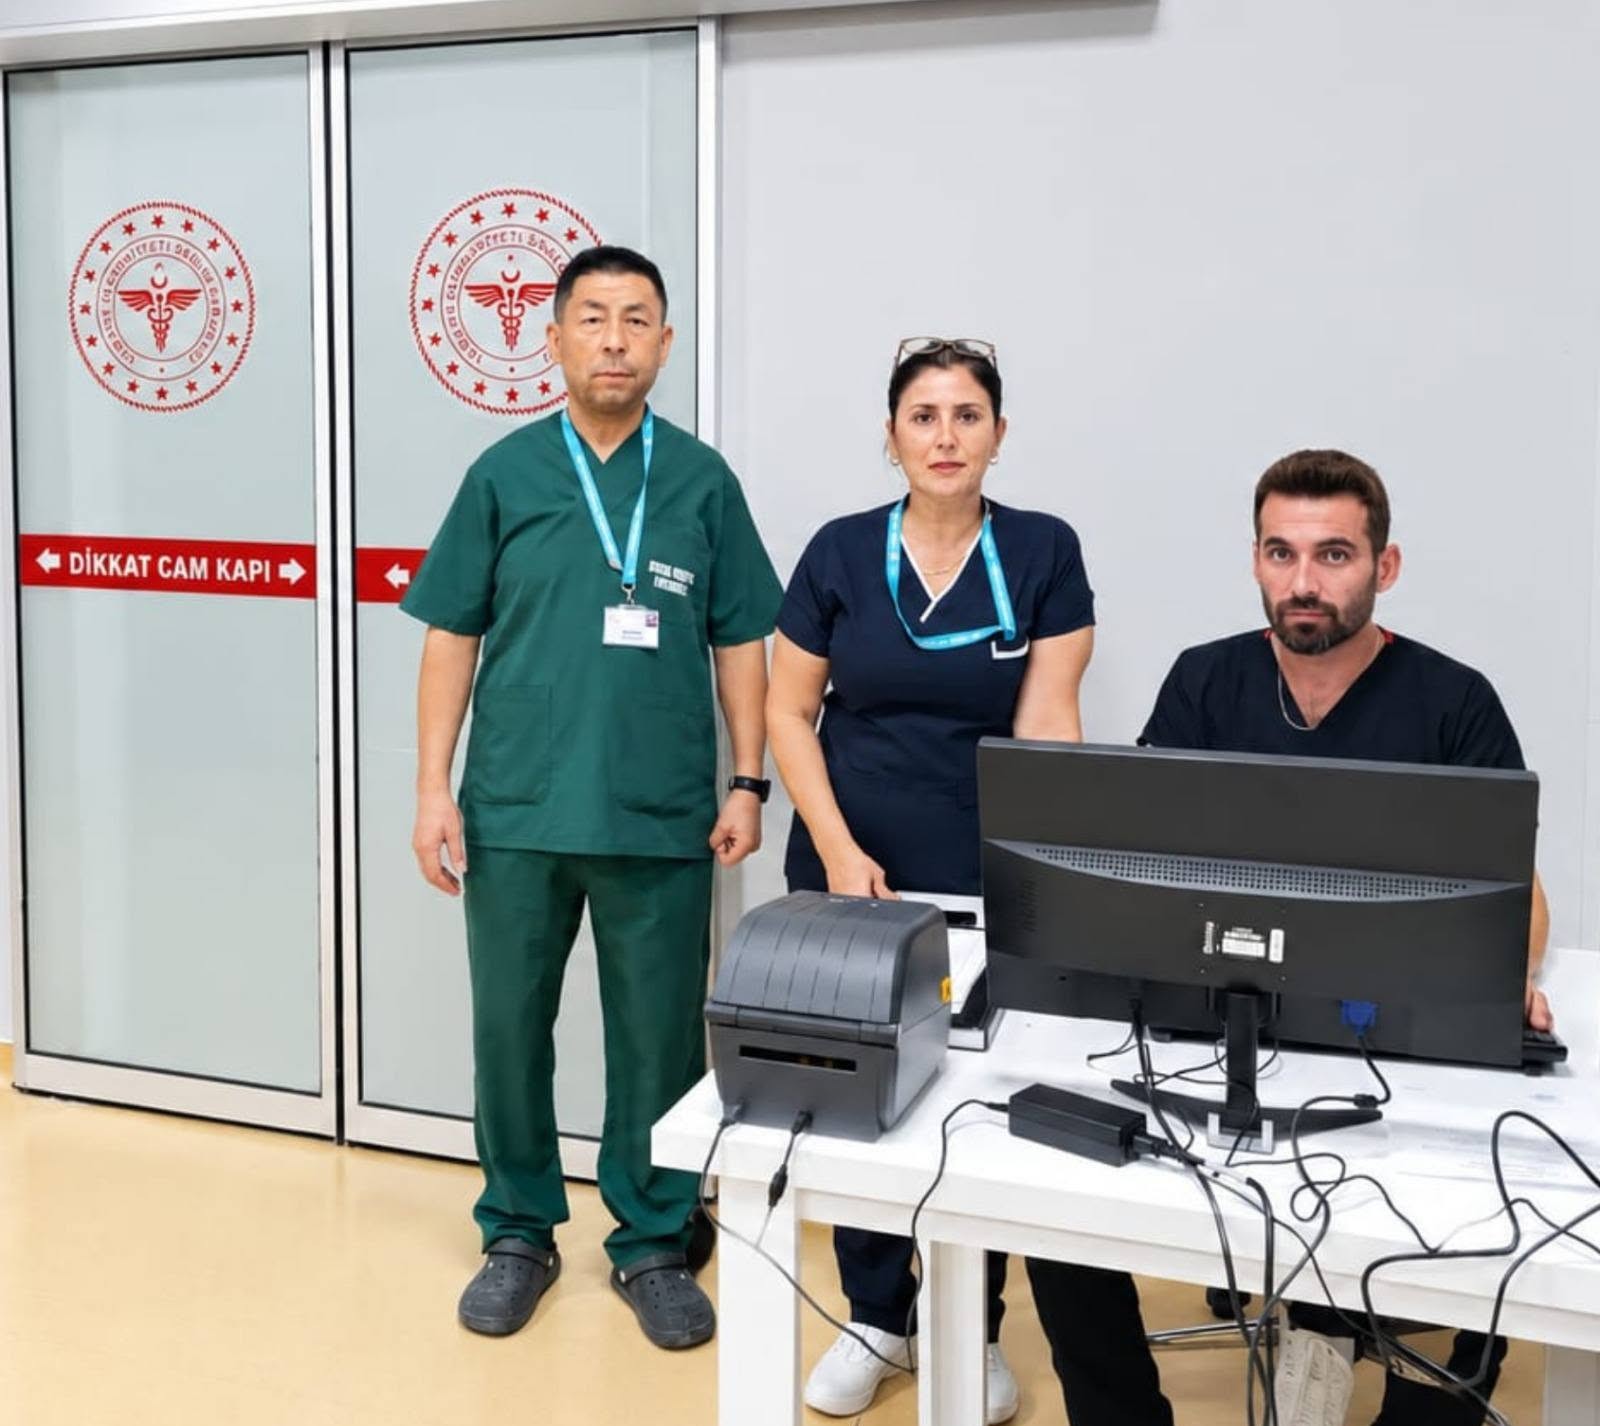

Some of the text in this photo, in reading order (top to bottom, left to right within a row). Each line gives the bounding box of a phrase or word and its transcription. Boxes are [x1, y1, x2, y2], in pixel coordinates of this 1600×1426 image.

[69, 547, 271, 583] DİKKAT CAM KAPI
